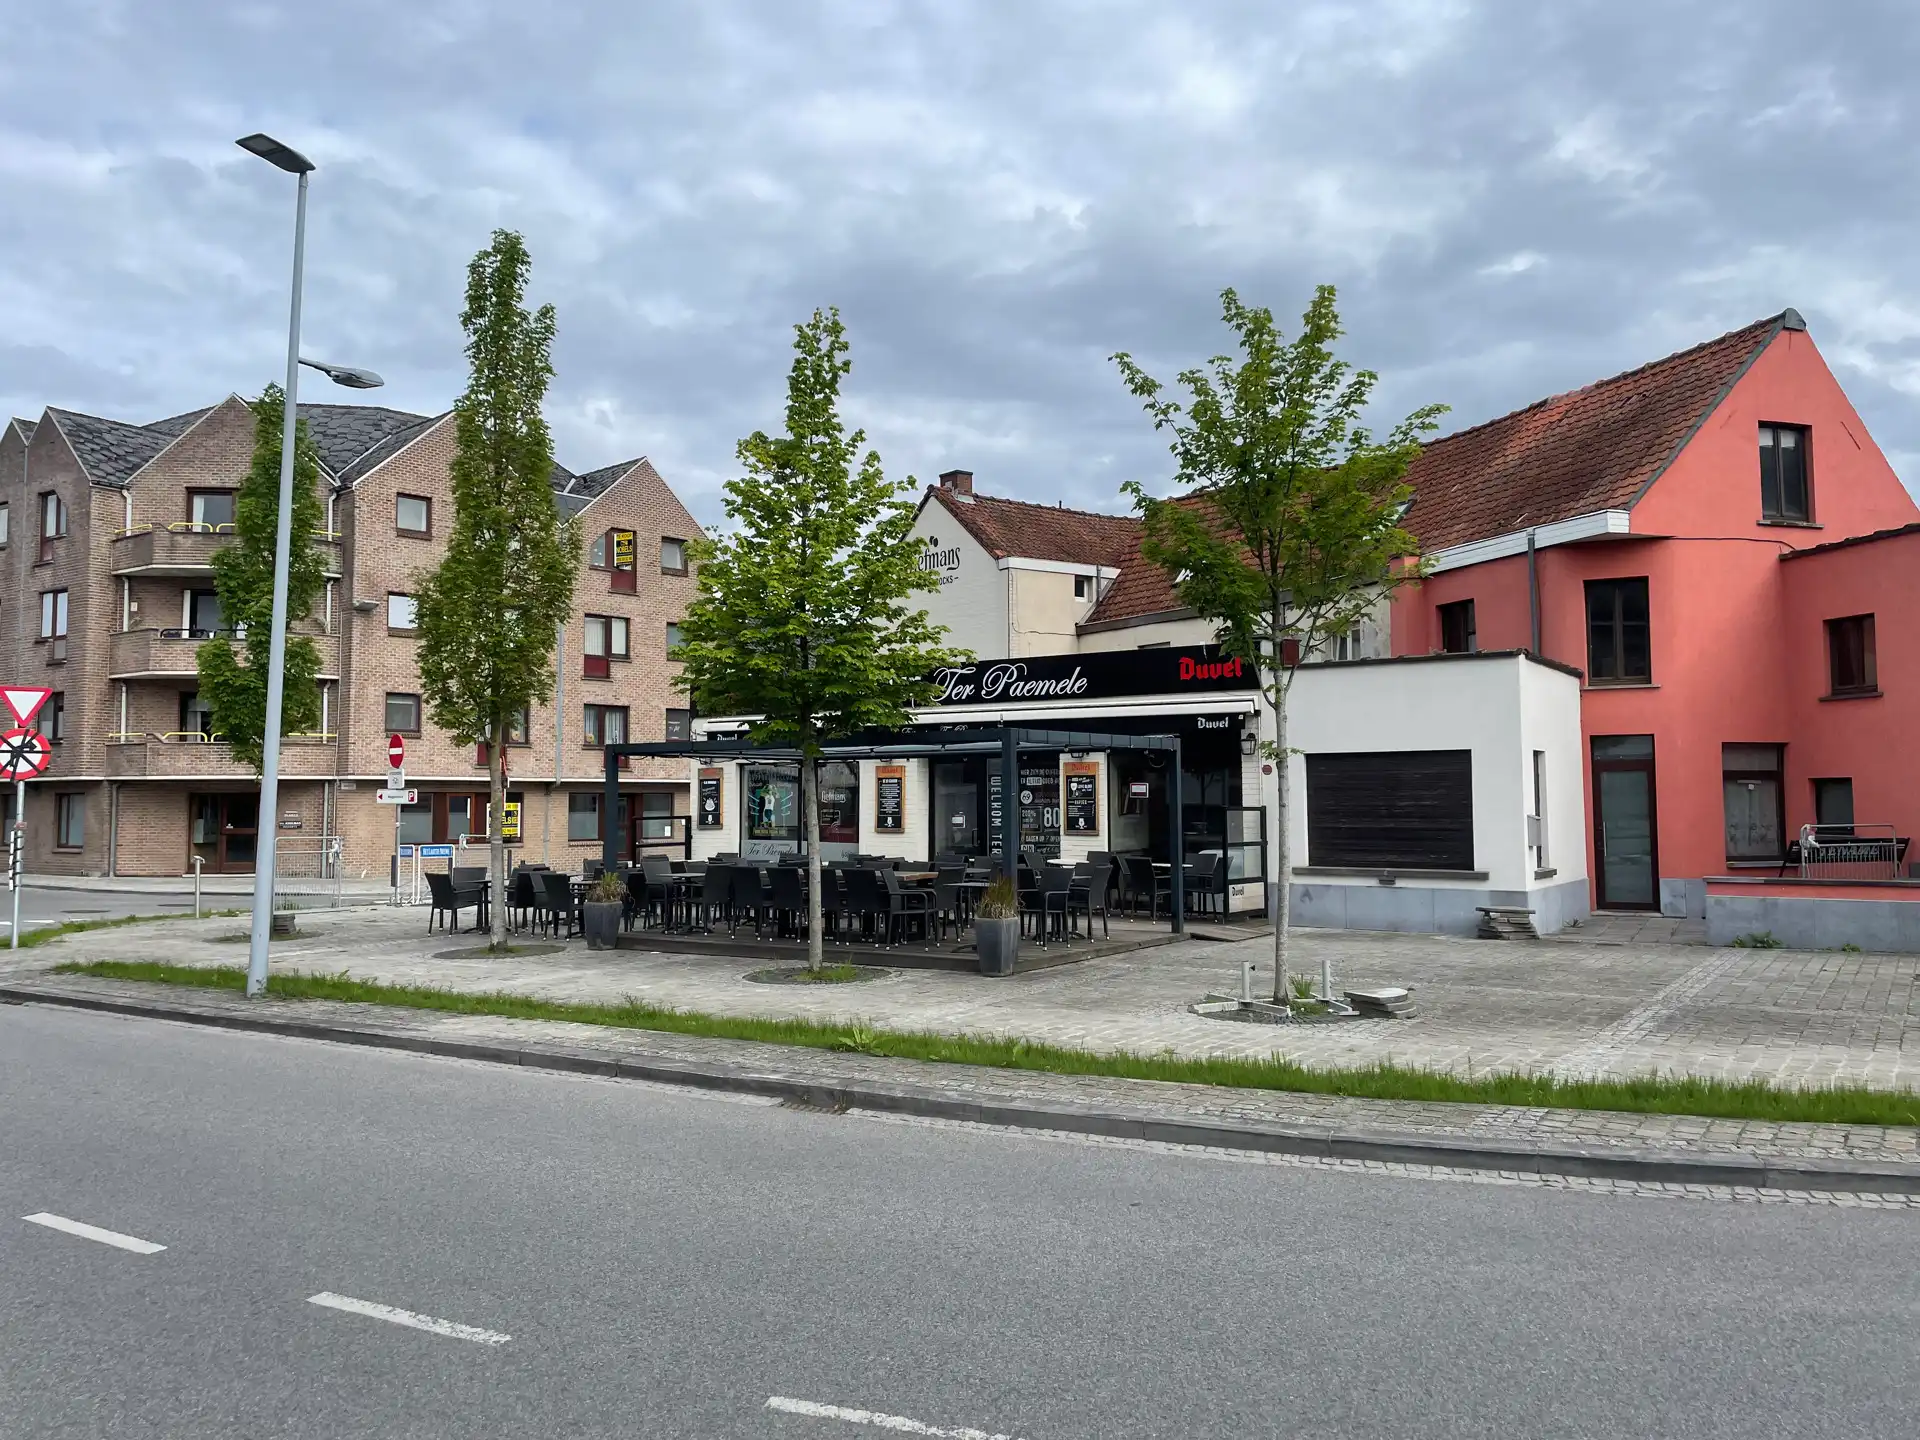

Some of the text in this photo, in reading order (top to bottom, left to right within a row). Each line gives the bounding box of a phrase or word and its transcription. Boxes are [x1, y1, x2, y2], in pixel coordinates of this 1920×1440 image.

[1179, 656, 1242, 680] Duvel
[930, 663, 1088, 702] Ter Paemele
[1197, 717, 1229, 728] Duvel
[990, 776, 1002, 827] WELKOM
[1043, 806, 1060, 828] 80
[991, 833, 1003, 855] TER
